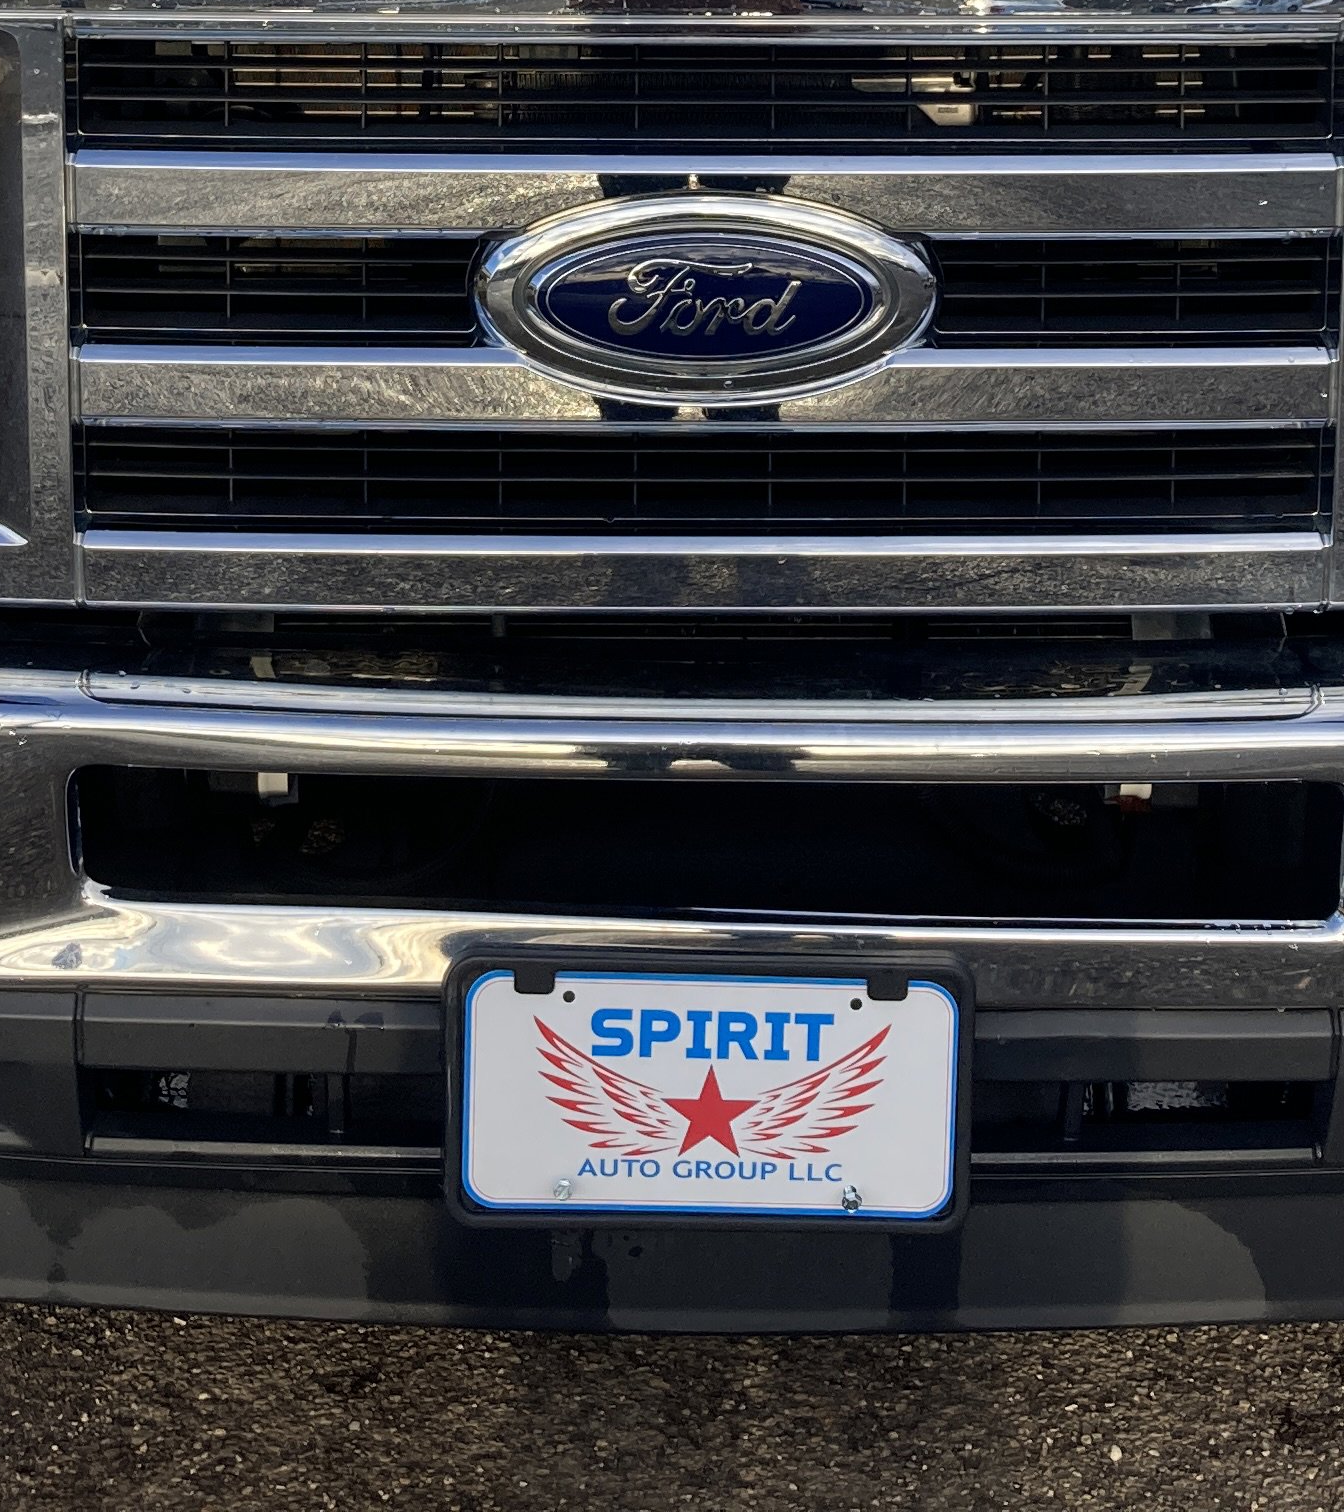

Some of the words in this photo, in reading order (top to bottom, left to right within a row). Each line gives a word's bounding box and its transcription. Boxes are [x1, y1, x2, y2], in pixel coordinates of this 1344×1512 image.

[607, 258, 802, 336] Ford
[590, 1007, 836, 1063] SPIRIT
[576, 1158, 662, 1178] AUTO
[672, 1159, 778, 1181] GROUP
[787, 1162, 843, 1183] LLC
